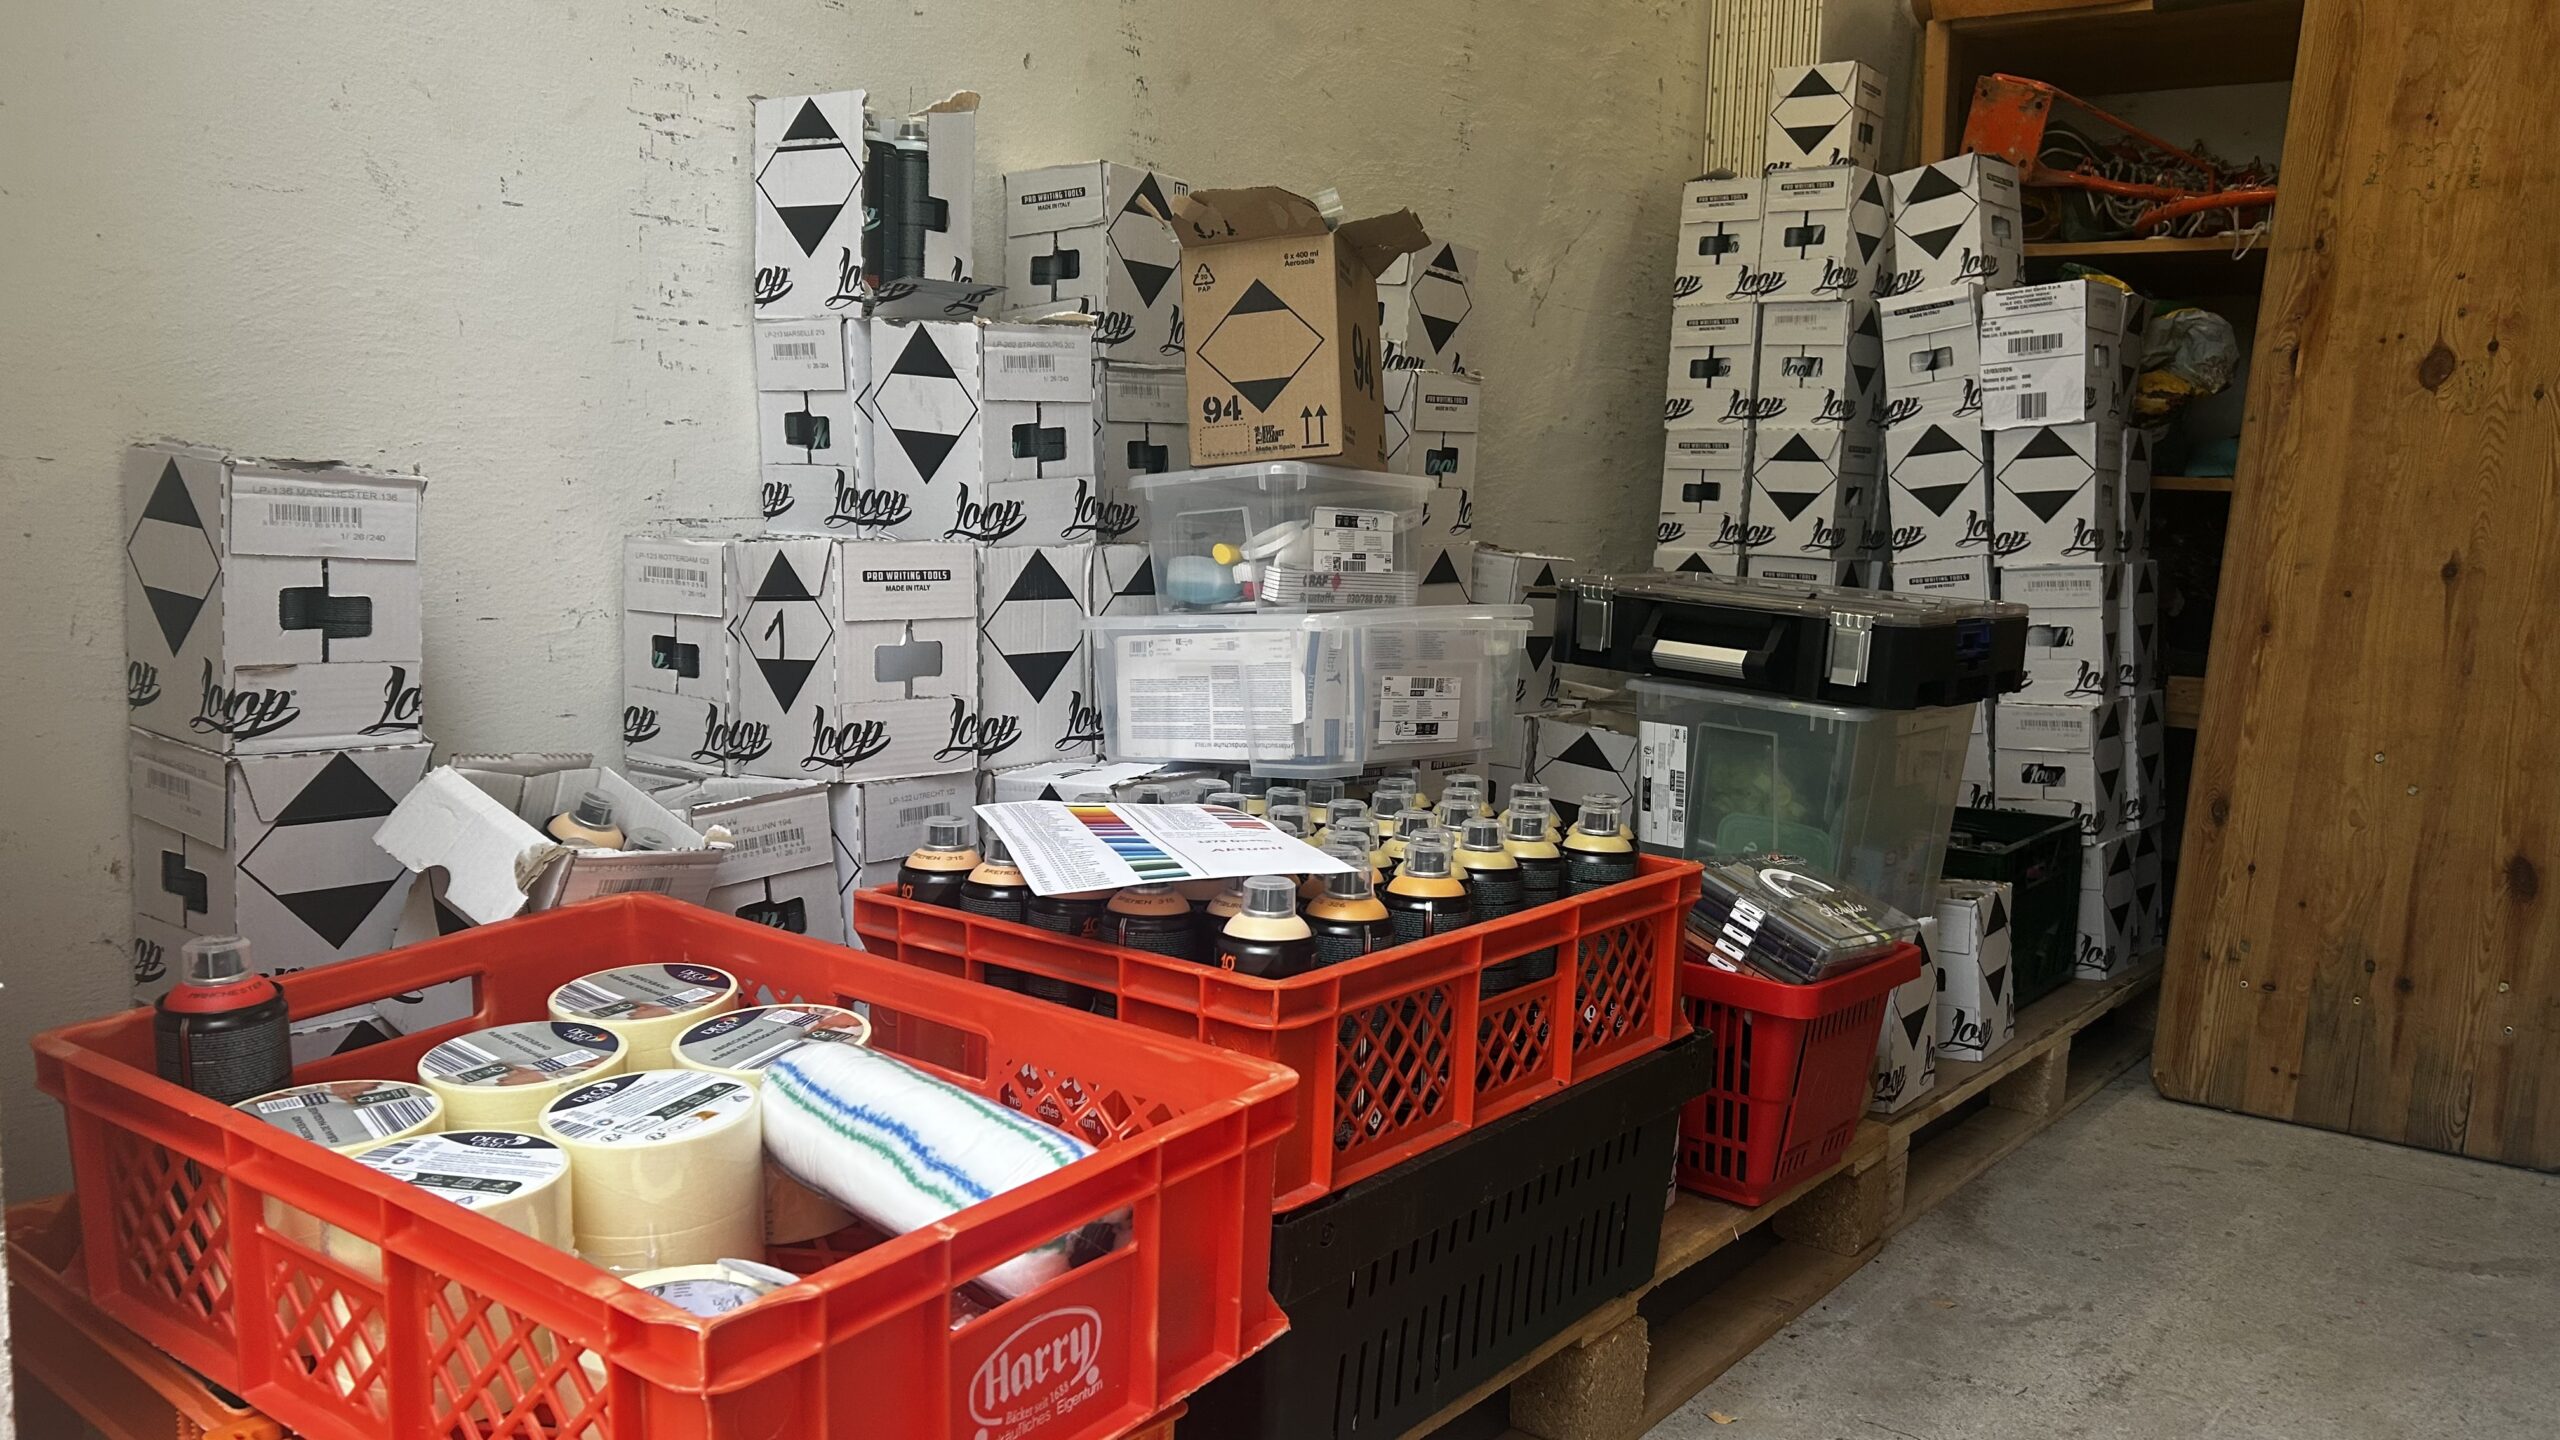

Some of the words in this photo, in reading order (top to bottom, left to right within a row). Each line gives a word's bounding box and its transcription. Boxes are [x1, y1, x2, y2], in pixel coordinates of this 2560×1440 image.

[1024, 195, 1036, 204] PRO
[1038, 191, 1063, 202] WRITING
[1064, 188, 1083, 198] TOOLS
[1284, 258, 1315, 267] Aerosols
[1295, 251, 1308, 259] 400
[755, 265, 794, 310] op
[1018, 341, 1063, 349] STRASBOURG
[252, 486, 293, 496] LP-136
[294, 487, 377, 501] MANCHESTER
[379, 493, 399, 502] 136
[762, 482, 795, 518] op
[944, 482, 1028, 541] Loop
[658, 552, 699, 564] ROTTERDAM
[866, 571, 884, 581] PRO
[886, 571, 921, 581] WRITING
[923, 570, 948, 581] TOOLS
[764, 608, 785, 661] 1
[129, 660, 161, 710] op
[190, 657, 301, 742] Loop
[624, 705, 661, 746] op
[934, 692, 1023, 763] Loop
[800, 704, 892, 770] Loop
[913, 789, 945, 801] UTRECHT
[743, 821, 776, 833] TALLINN
[1211, 845, 1283, 853] Aktuell
[1221, 952, 1236, 971] 10
[681, 968, 715, 982] DECO
[568, 1027, 599, 1042] DECO
[700, 1016, 740, 1036] DECO
[748, 1025, 788, 1045] MASQUAGE
[711, 1027, 764, 1053] ABDECKBAND
[572, 1083, 613, 1103] DECO
[470, 1135, 519, 1146] DECO
[984, 1321, 1091, 1411] Harry
[1057, 1379, 1104, 1415] Eigentum
[1005, 1405, 1034, 1425] Bäcker
[1034, 1396, 1049, 1413] seit
